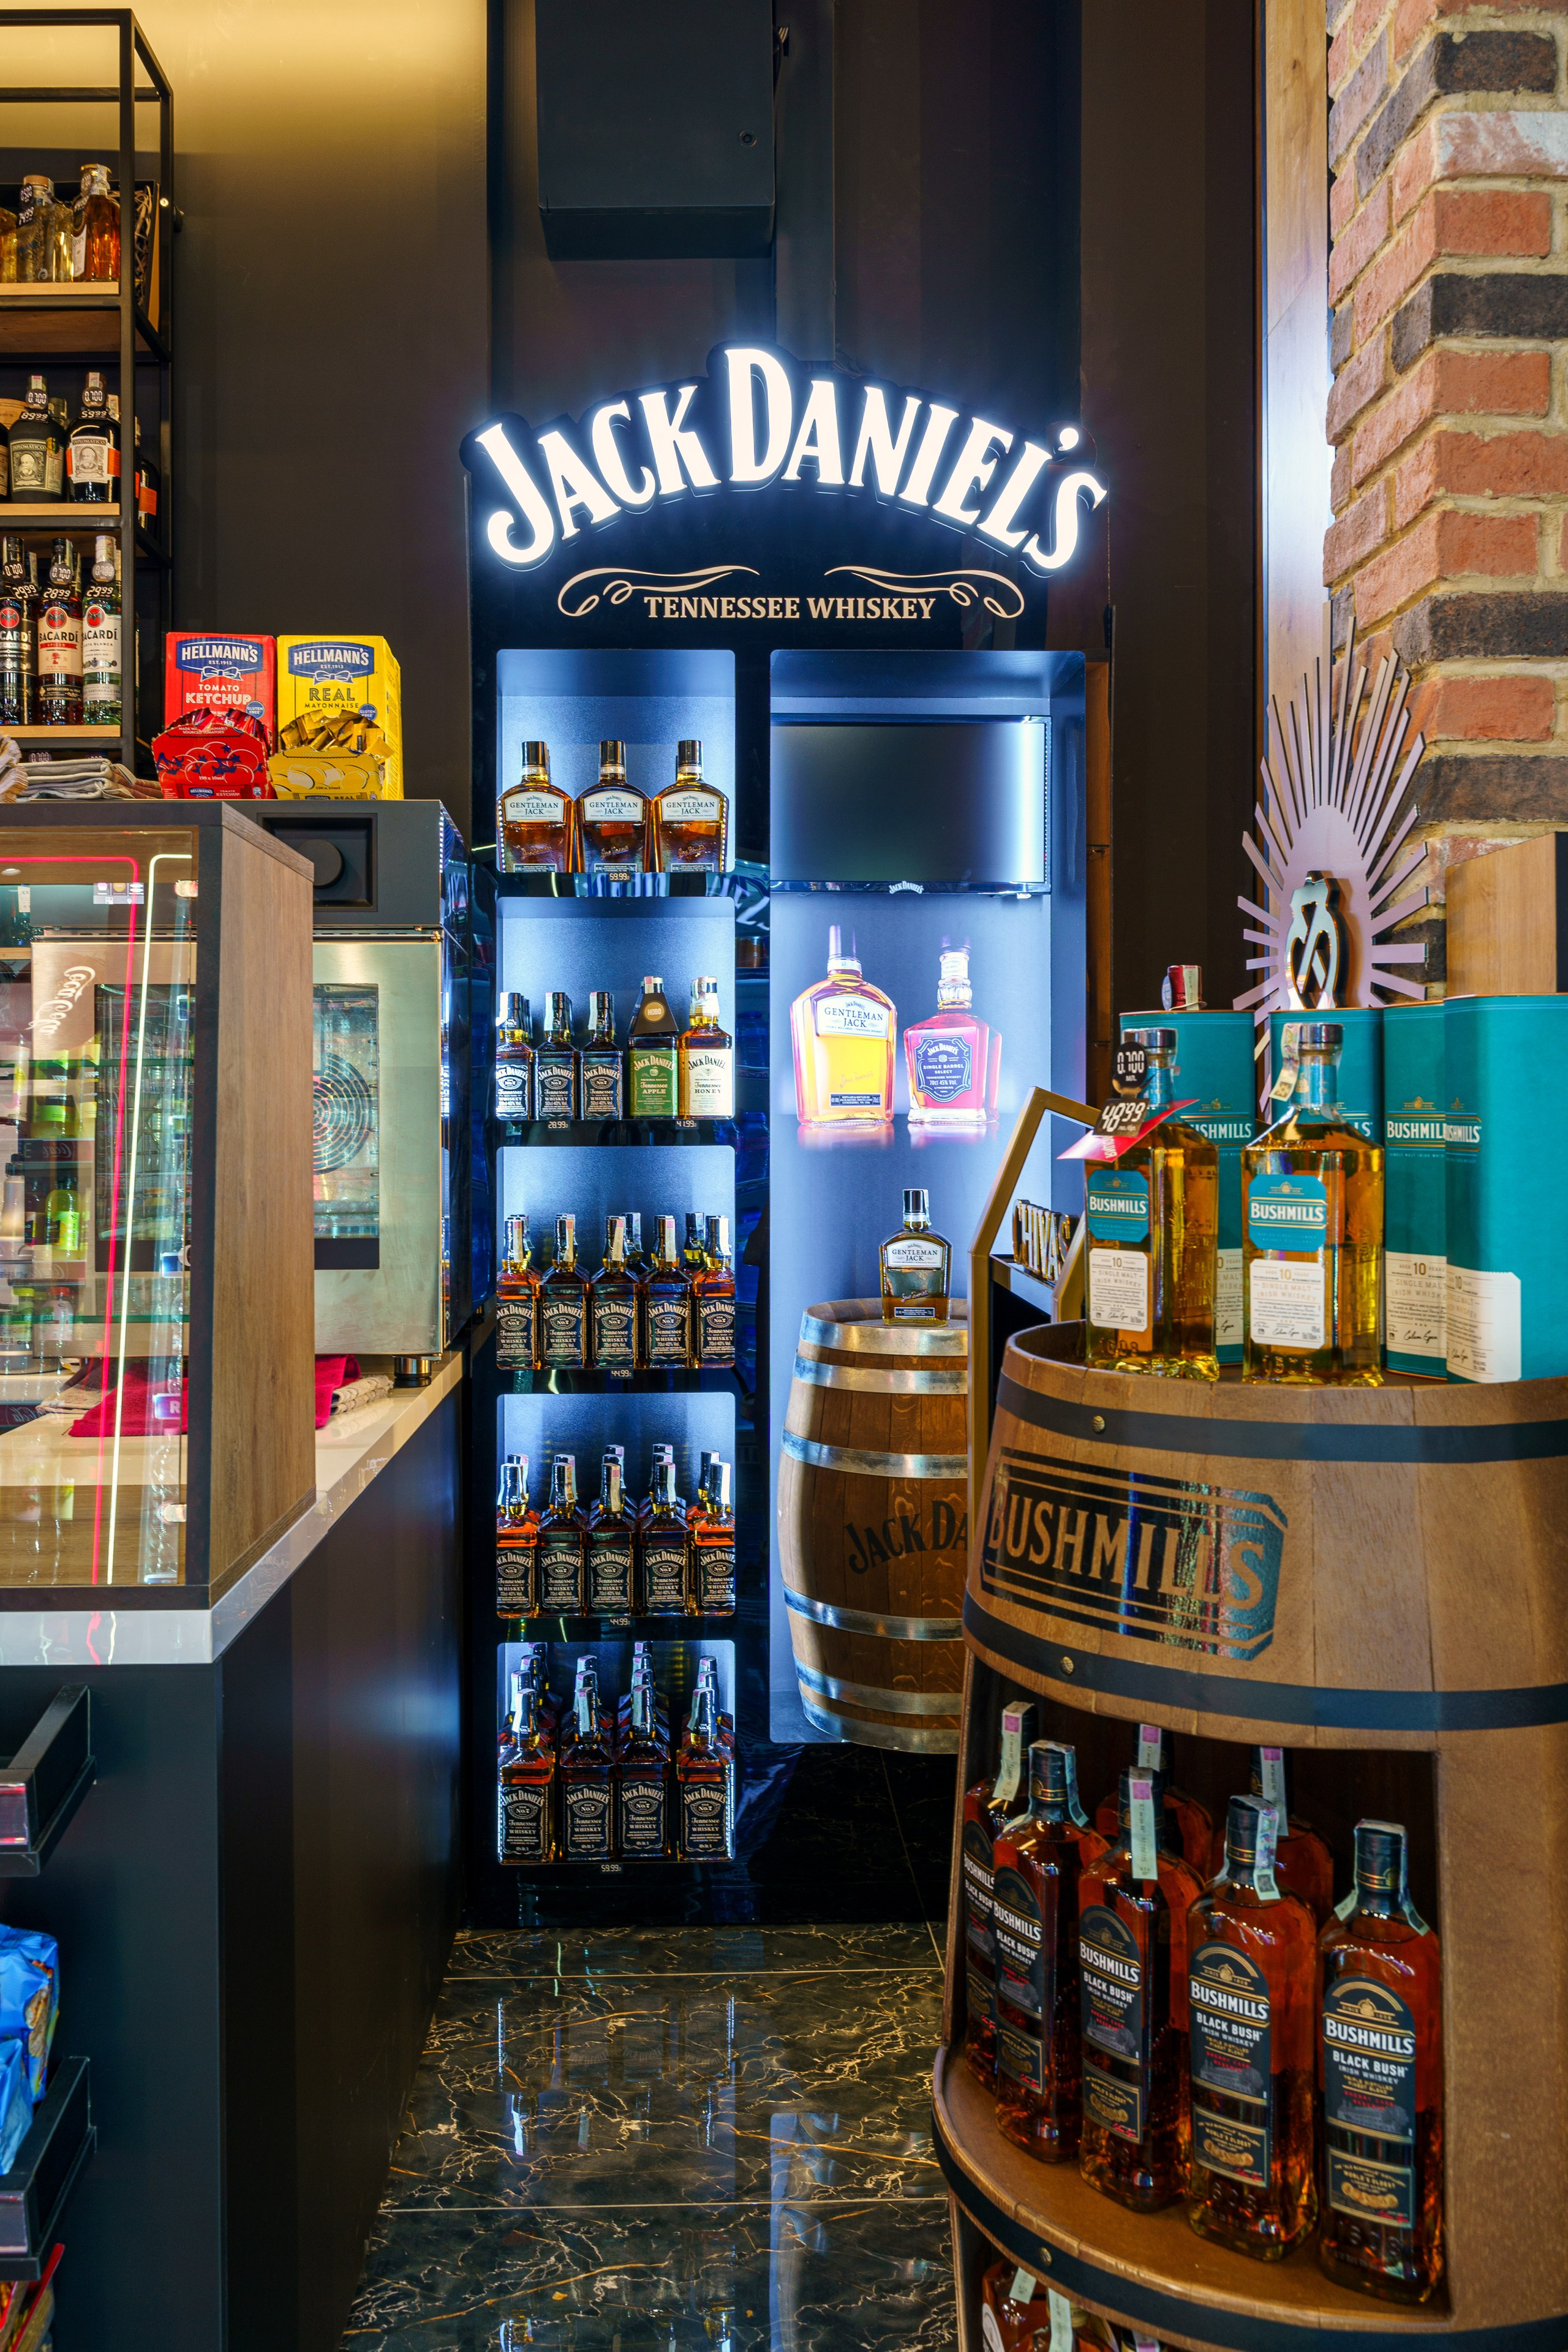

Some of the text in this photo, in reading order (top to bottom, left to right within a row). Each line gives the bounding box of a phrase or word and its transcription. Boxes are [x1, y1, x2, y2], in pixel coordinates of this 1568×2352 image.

[475, 347, 1108, 570] JACK DANIEL'S
[644, 597, 936, 620] TENNESSEE WHISKEY
[0, 630, 32, 643] CARDÍ
[182, 644, 258, 663] HELLMANN'S
[293, 648, 369, 666] HELLMANN'S
[186, 693, 252, 705] KETCHUP
[309, 688, 355, 701] REAL
[889, 880, 924, 894] JACK DANIEL'S
[824, 1007, 883, 1021] GENTLEMAN
[843, 1018, 867, 1028] JACK
[633, 1057, 650, 1071] JACK
[688, 1057, 706, 1071] JACK
[1117, 1050, 1145, 1074] 0.700
[496, 1068, 507, 1079] ACK
[1090, 1196, 1147, 1214] BUSHMILLS
[1251, 1202, 1324, 1222] BUSHMILLS
[1112, 1257, 1122, 1267] 10
[1413, 1262, 1426, 1275] 10
[1280, 1268, 1292, 1281] 10
[1396, 1279, 1423, 1287] SINGLE
[1415, 1289, 1447, 1300] WHISKE
[543, 1306, 559, 1319] JACK
[594, 1306, 611, 1319] JACK
[648, 1305, 665, 1318] JACK
[699, 1304, 715, 1317] JACK
[845, 1513, 929, 1574] JACK
[987, 1483, 1265, 1611] BUSHMILLS
[541, 1555, 557, 1567] JACK
[590, 1555, 607, 1567] JACK
[646, 1554, 662, 1566] JACK
[700, 1553, 716, 1566] JACK
[501, 1790, 545, 1807] JACK DANIEL'S
[567, 1788, 610, 1805] JACK DANIEL'S
[622, 1785, 665, 1802] JACK DANIEL'S
[684, 1788, 727, 1804] JACK DANIEL'S
[993, 1901, 1041, 1942] BUSHMILLS
[997, 1929, 1036, 1960] BLACK BUSH
[1080, 1941, 1139, 1983] BUSHMILLS
[1084, 1971, 1133, 2003] BLACK BUSH
[1191, 1980, 1268, 2020] BUSHMILLS
[1196, 2011, 1261, 2041] BLACK BUSH
[1201, 2026, 1254, 2048] IRISH WHISKEY
[1326, 2018, 1414, 2055] BUSHMILLS
[1333, 2050, 1406, 2078] BLACK BUSH
[1338, 2065, 1399, 2086] IRISH WHISKEY
